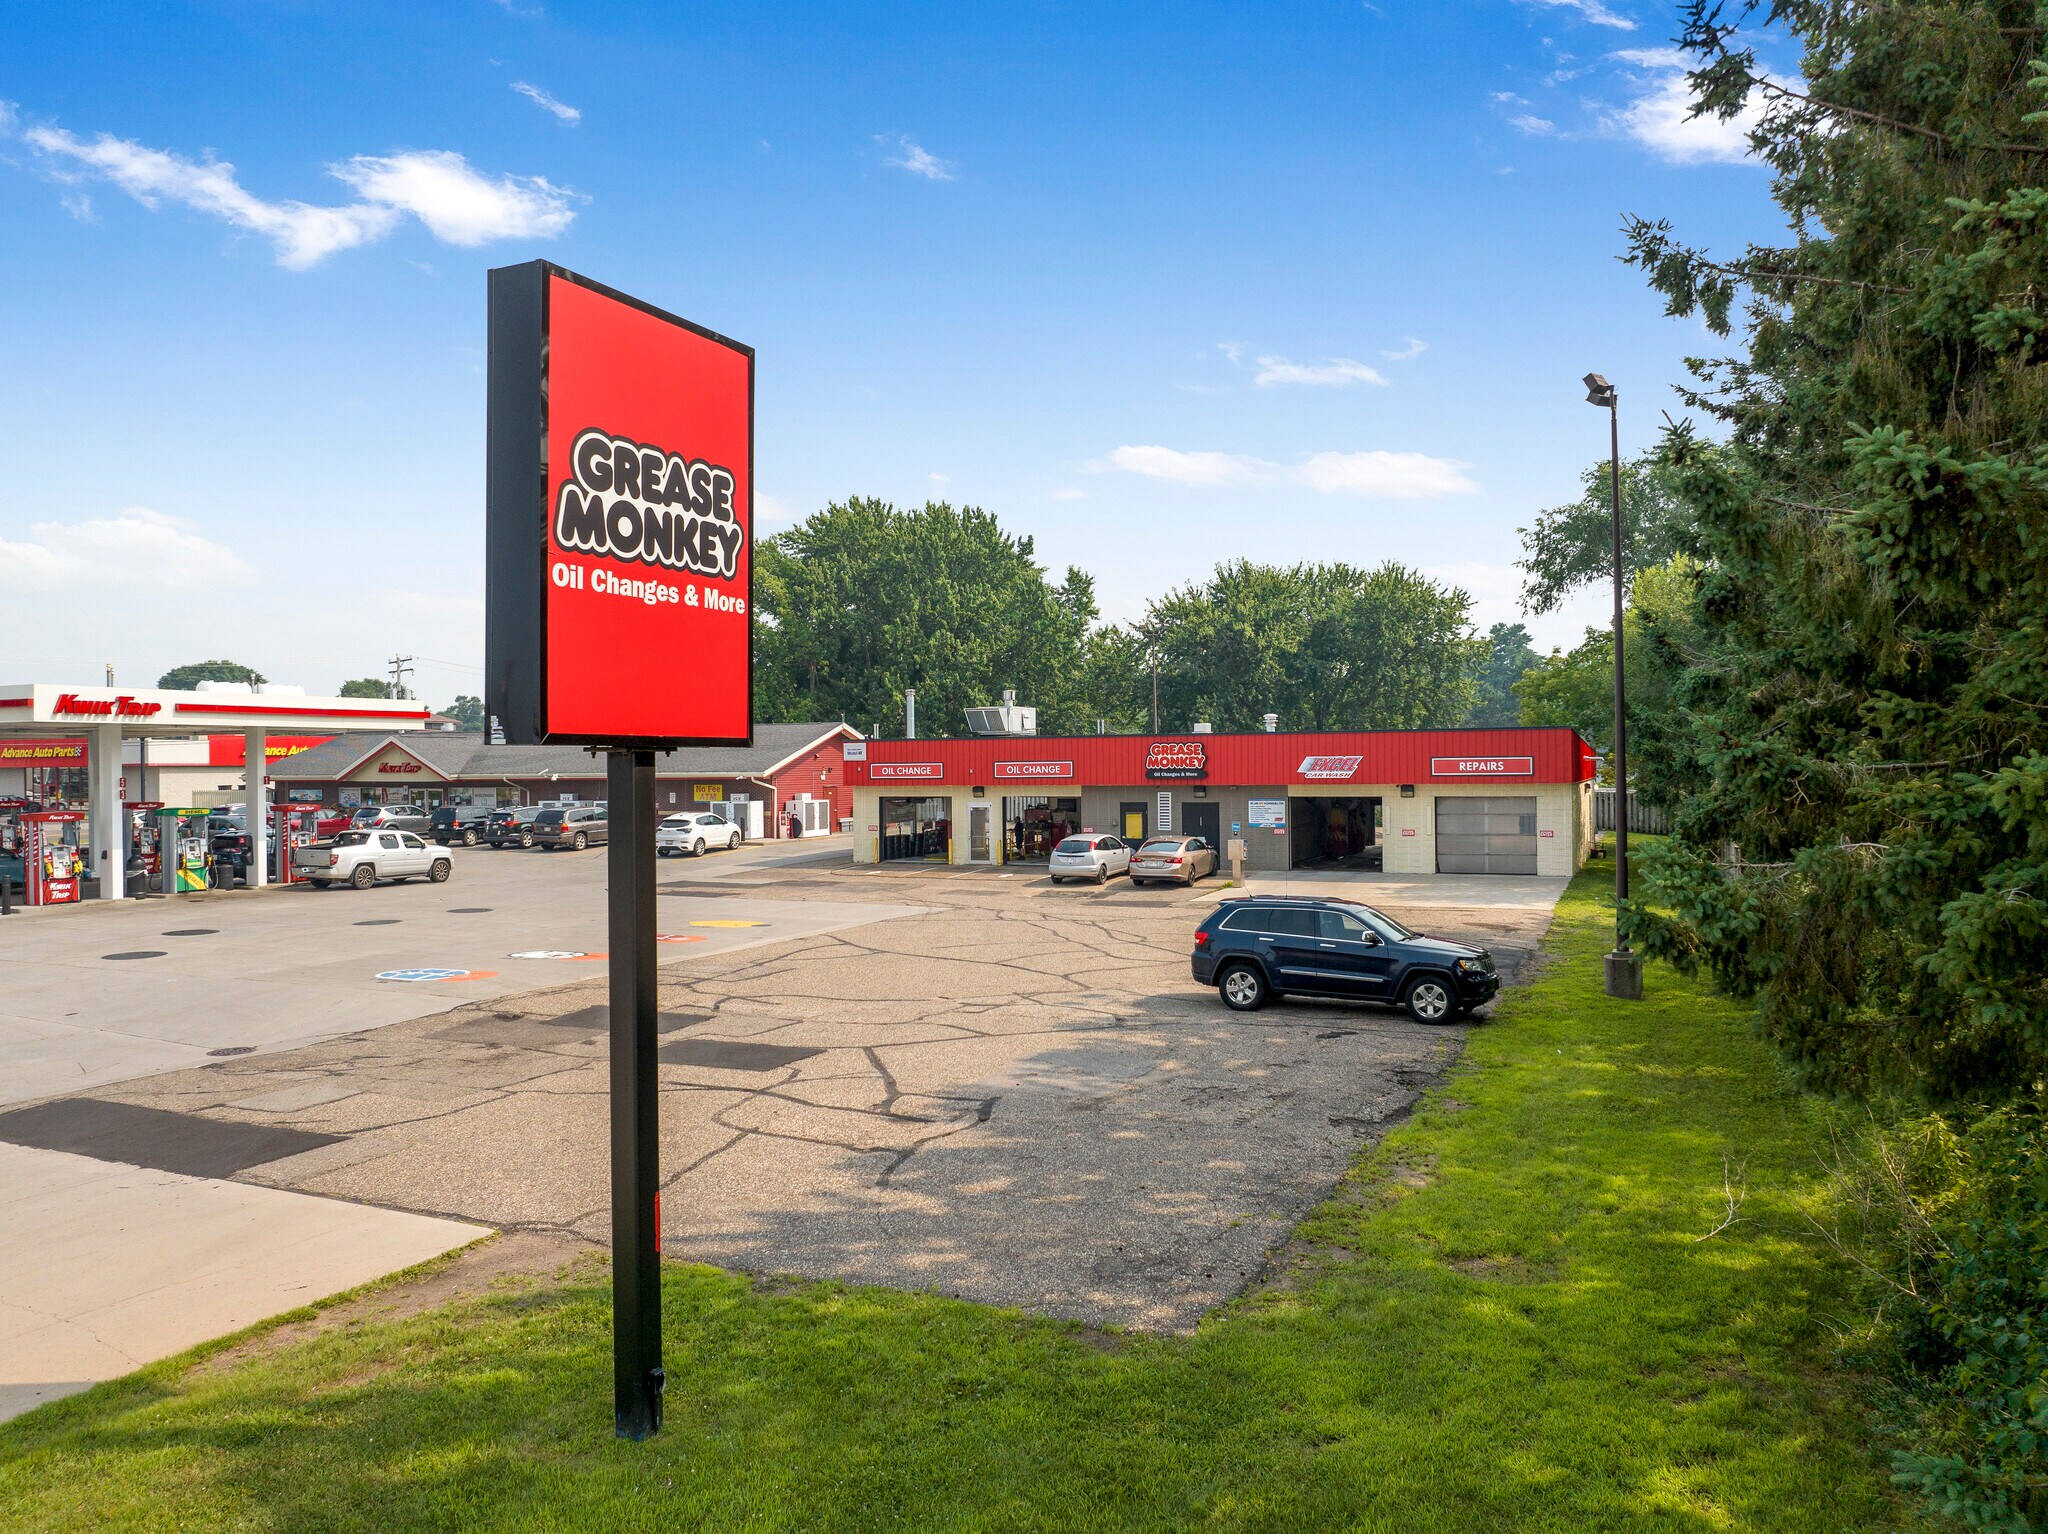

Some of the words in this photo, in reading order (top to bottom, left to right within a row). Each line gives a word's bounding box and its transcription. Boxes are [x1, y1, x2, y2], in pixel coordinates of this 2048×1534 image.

[575, 434, 734, 524] GREASE
[558, 485, 742, 576] MONKEY
[552, 562, 584, 590] Oil
[591, 568, 679, 605] Changes
[684, 584, 699, 607] &
[704, 587, 746, 615] More
[1, 747, 33, 759] Advance
[33, 747, 53, 758] Auto
[53, 746, 76, 758] Parts
[1150, 743, 1202, 757] GREASE
[1146, 755, 1206, 769] MONKEY
[1309, 757, 1359, 772] EXCEL
[1459, 761, 1504, 771] REPAIRS
[881, 767, 895, 775] OIL
[896, 766, 931, 775] CHANGE
[1006, 766, 1021, 774] OIL
[1022, 765, 1060, 774] CHANGE
[120, 778, 125, 787] 5
[120, 790, 125, 799] 3
[696, 785, 706, 793] No
[708, 785, 721, 793] Fee
[700, 793, 716, 801] ATM
